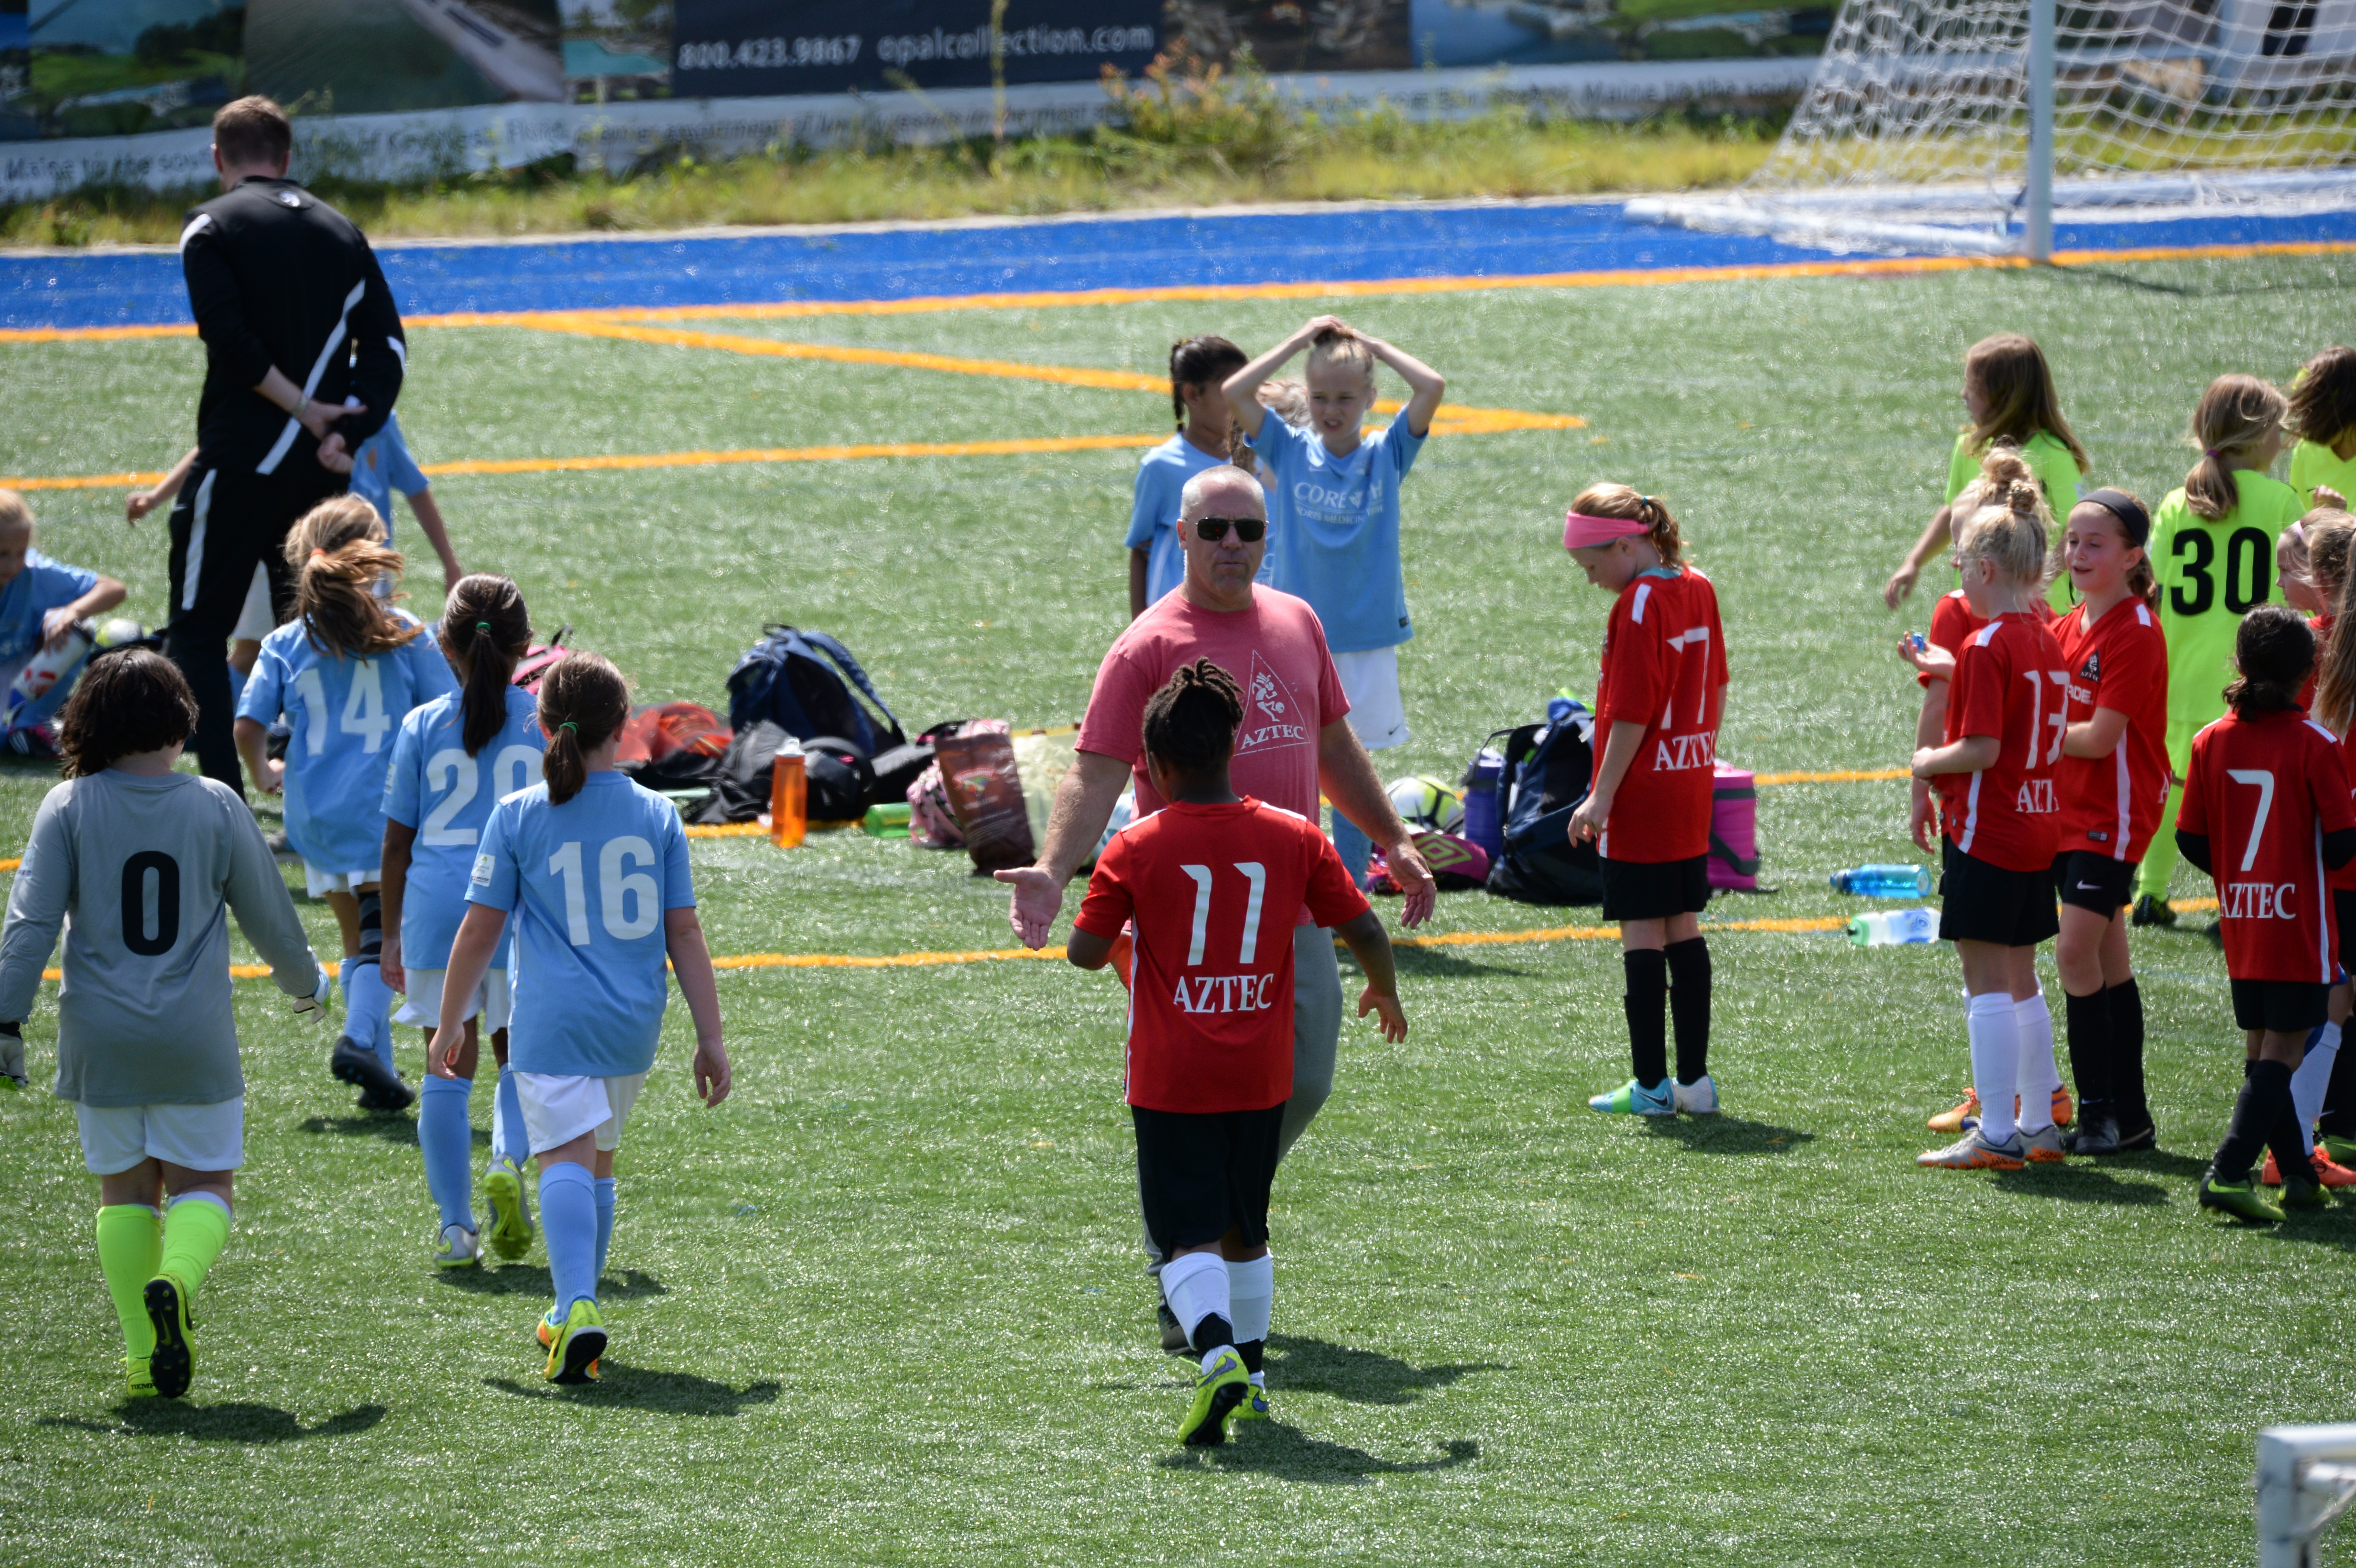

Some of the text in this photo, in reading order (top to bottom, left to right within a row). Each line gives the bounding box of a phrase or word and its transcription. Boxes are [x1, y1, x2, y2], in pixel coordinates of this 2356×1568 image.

[677, 23, 1154, 70] 800.423.9867 opalcollection.com
[2171, 527, 2271, 615] 30
[295, 660, 391, 757] 14
[1240, 724, 1305, 751] AZTEC
[2226, 769, 2274, 871] 7
[121, 850, 180, 956] 0
[549, 836, 659, 946] 16
[1180, 862, 1266, 966] 11
[2221, 883, 2296, 919] AZTEC
[1174, 974, 1274, 1013] AZTEC
